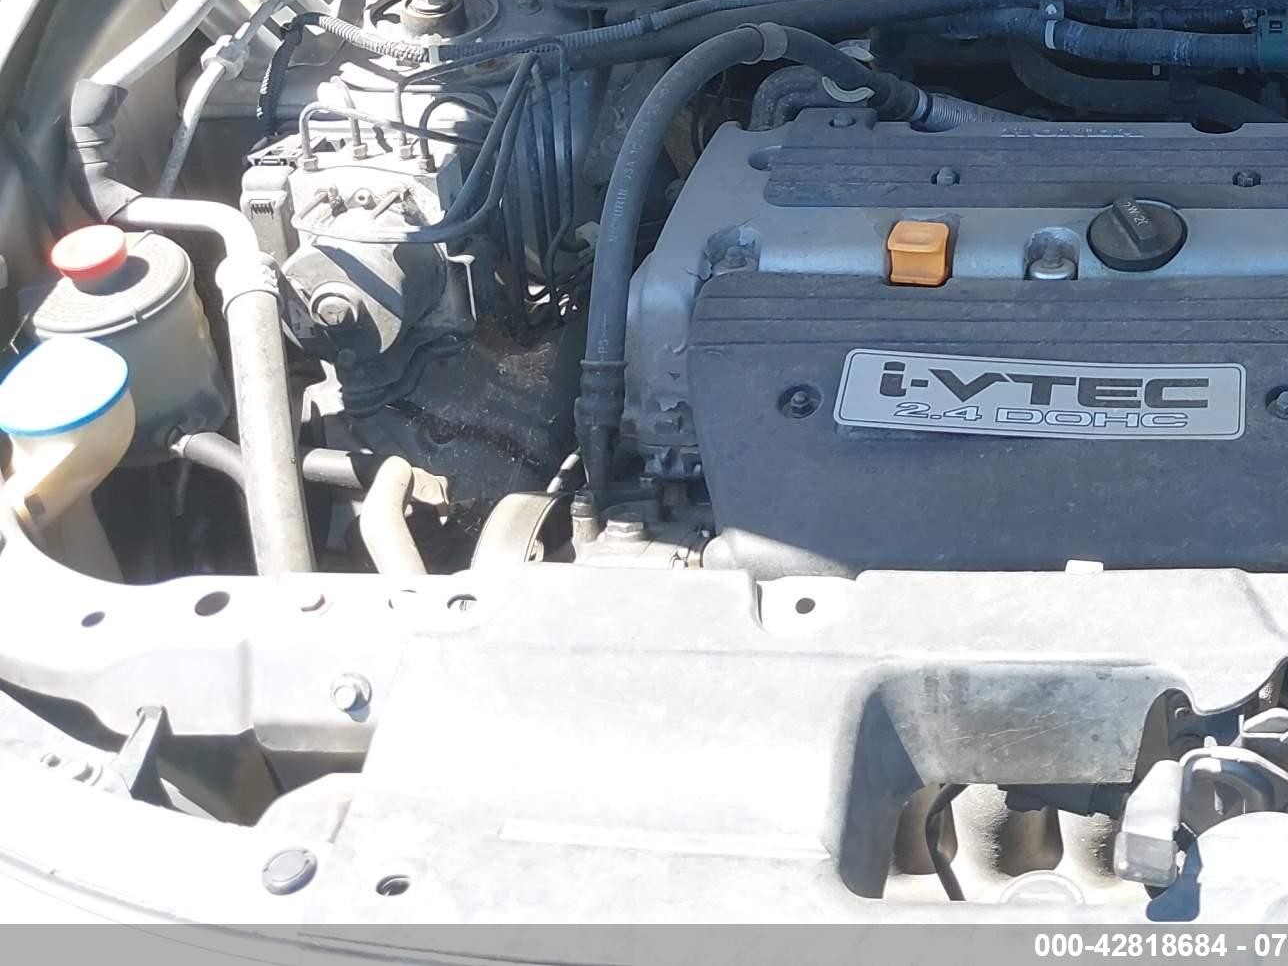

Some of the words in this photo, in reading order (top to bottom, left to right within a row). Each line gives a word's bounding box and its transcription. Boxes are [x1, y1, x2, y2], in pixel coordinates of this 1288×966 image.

[879, 360, 1210, 409] i-VTEC
[894, 401, 983, 422] 2.4
[994, 407, 1189, 429] DOHC
